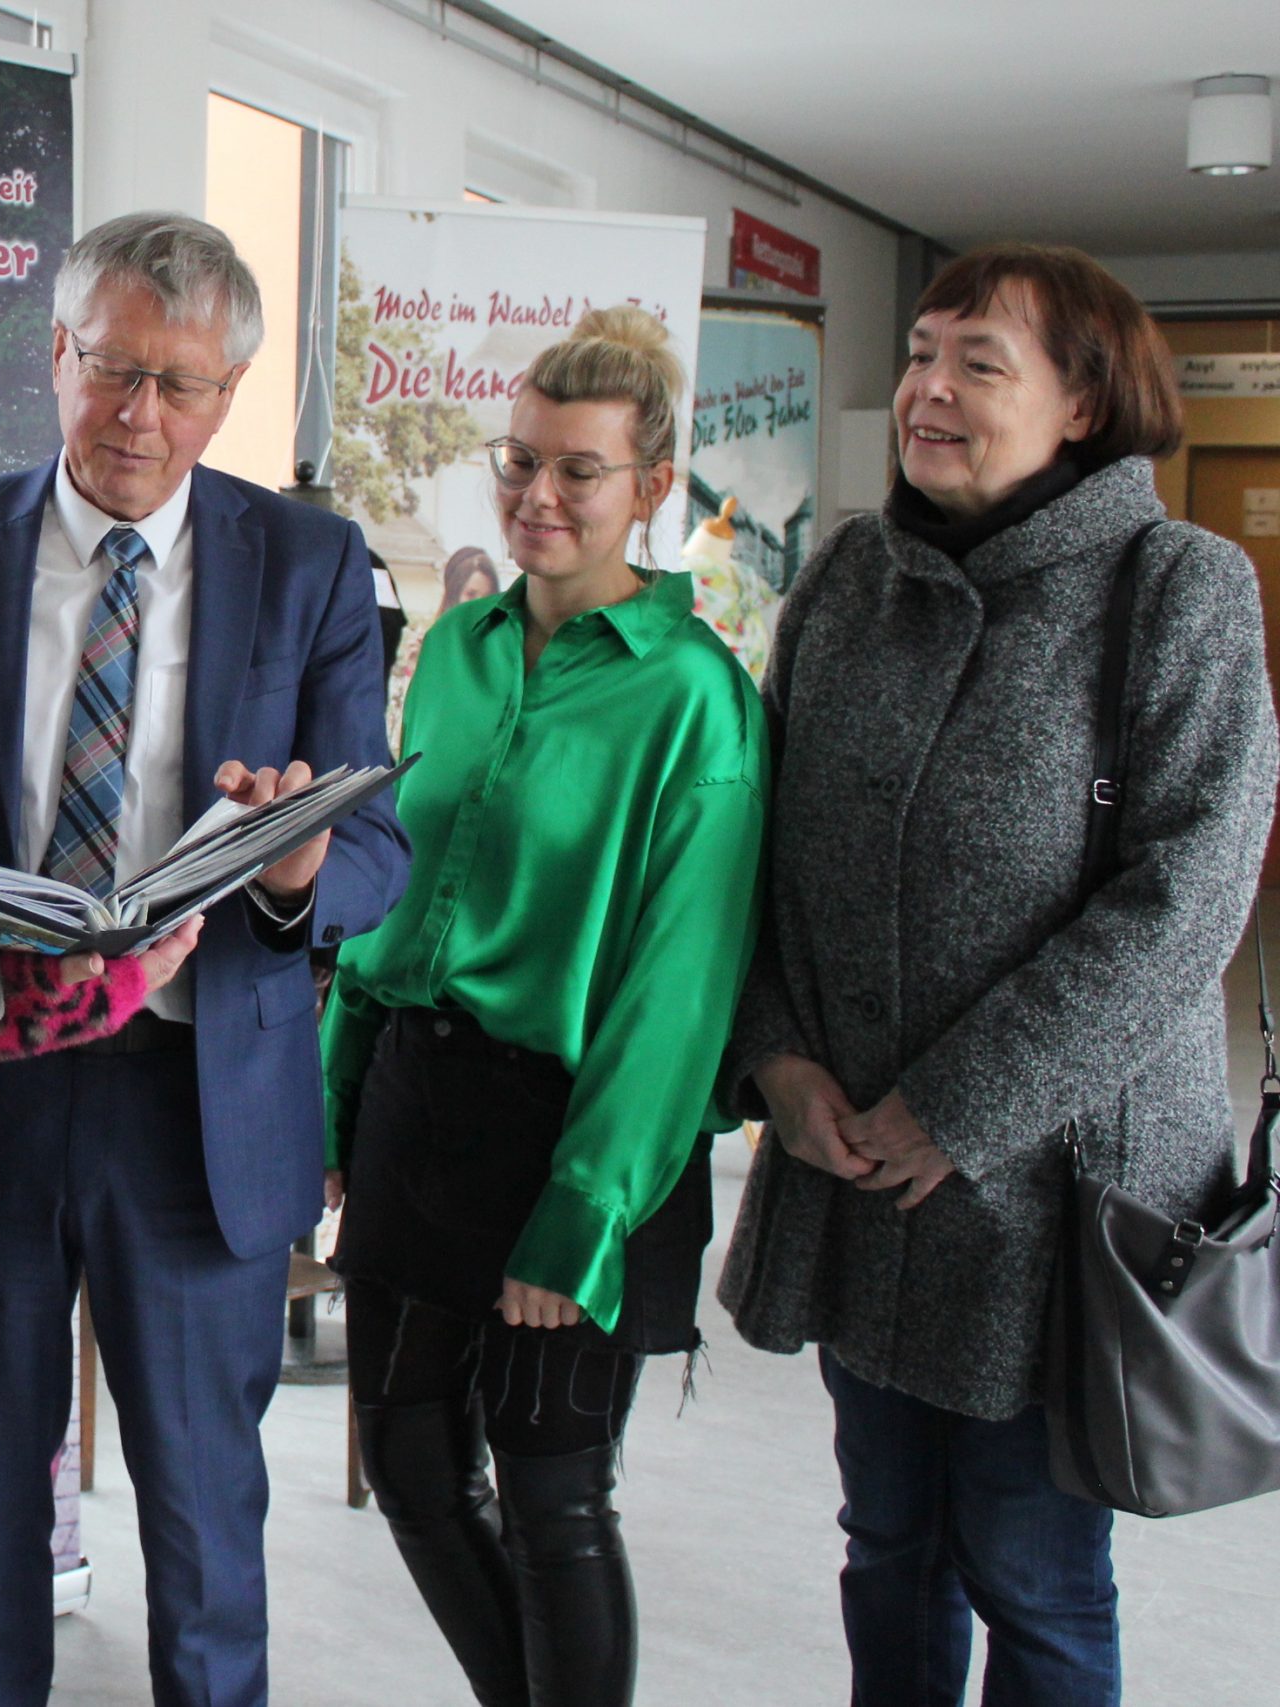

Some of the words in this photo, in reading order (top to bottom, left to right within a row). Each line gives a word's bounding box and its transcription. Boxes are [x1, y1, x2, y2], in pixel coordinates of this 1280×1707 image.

[374, 286, 441, 324] Mode
[449, 294, 477, 323] im
[488, 290, 573, 327] Wandel
[366, 342, 431, 404] Die
[690, 415, 717, 455] Die
[724, 404, 758, 441] 50er
[765, 392, 811, 438] Jahre
